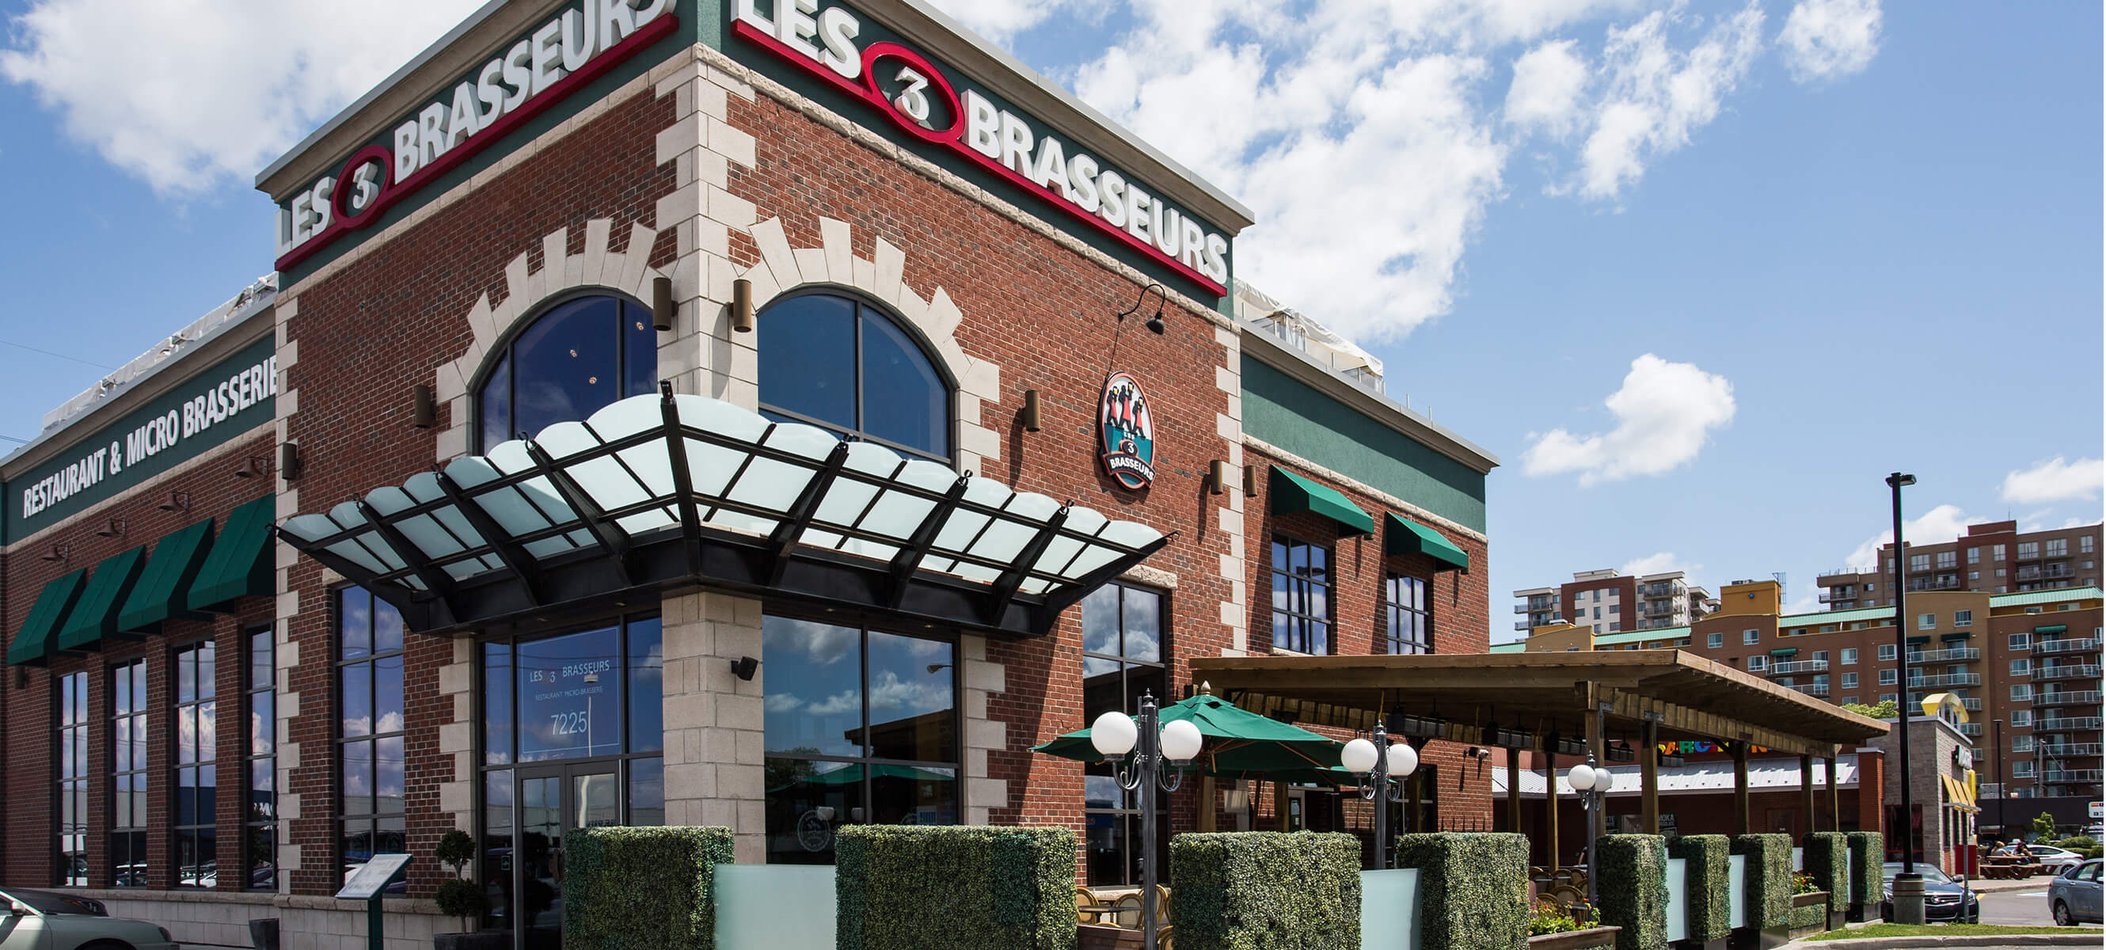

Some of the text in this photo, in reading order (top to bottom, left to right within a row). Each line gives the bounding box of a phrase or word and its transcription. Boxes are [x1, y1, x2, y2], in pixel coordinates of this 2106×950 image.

[352, 160, 378, 209] 3
[893, 67, 930, 122] 3
[961, 89, 1229, 285] BRASSEURS
[23, 354, 277, 519] RESTAURANT & MICRO BRASSERIE
[1127, 443, 1135, 453] 3
[1109, 457, 1154, 481] BRASSEURS
[529, 659, 610, 684] LES 3 BRASSEURS
[550, 711, 588, 736] 7225
